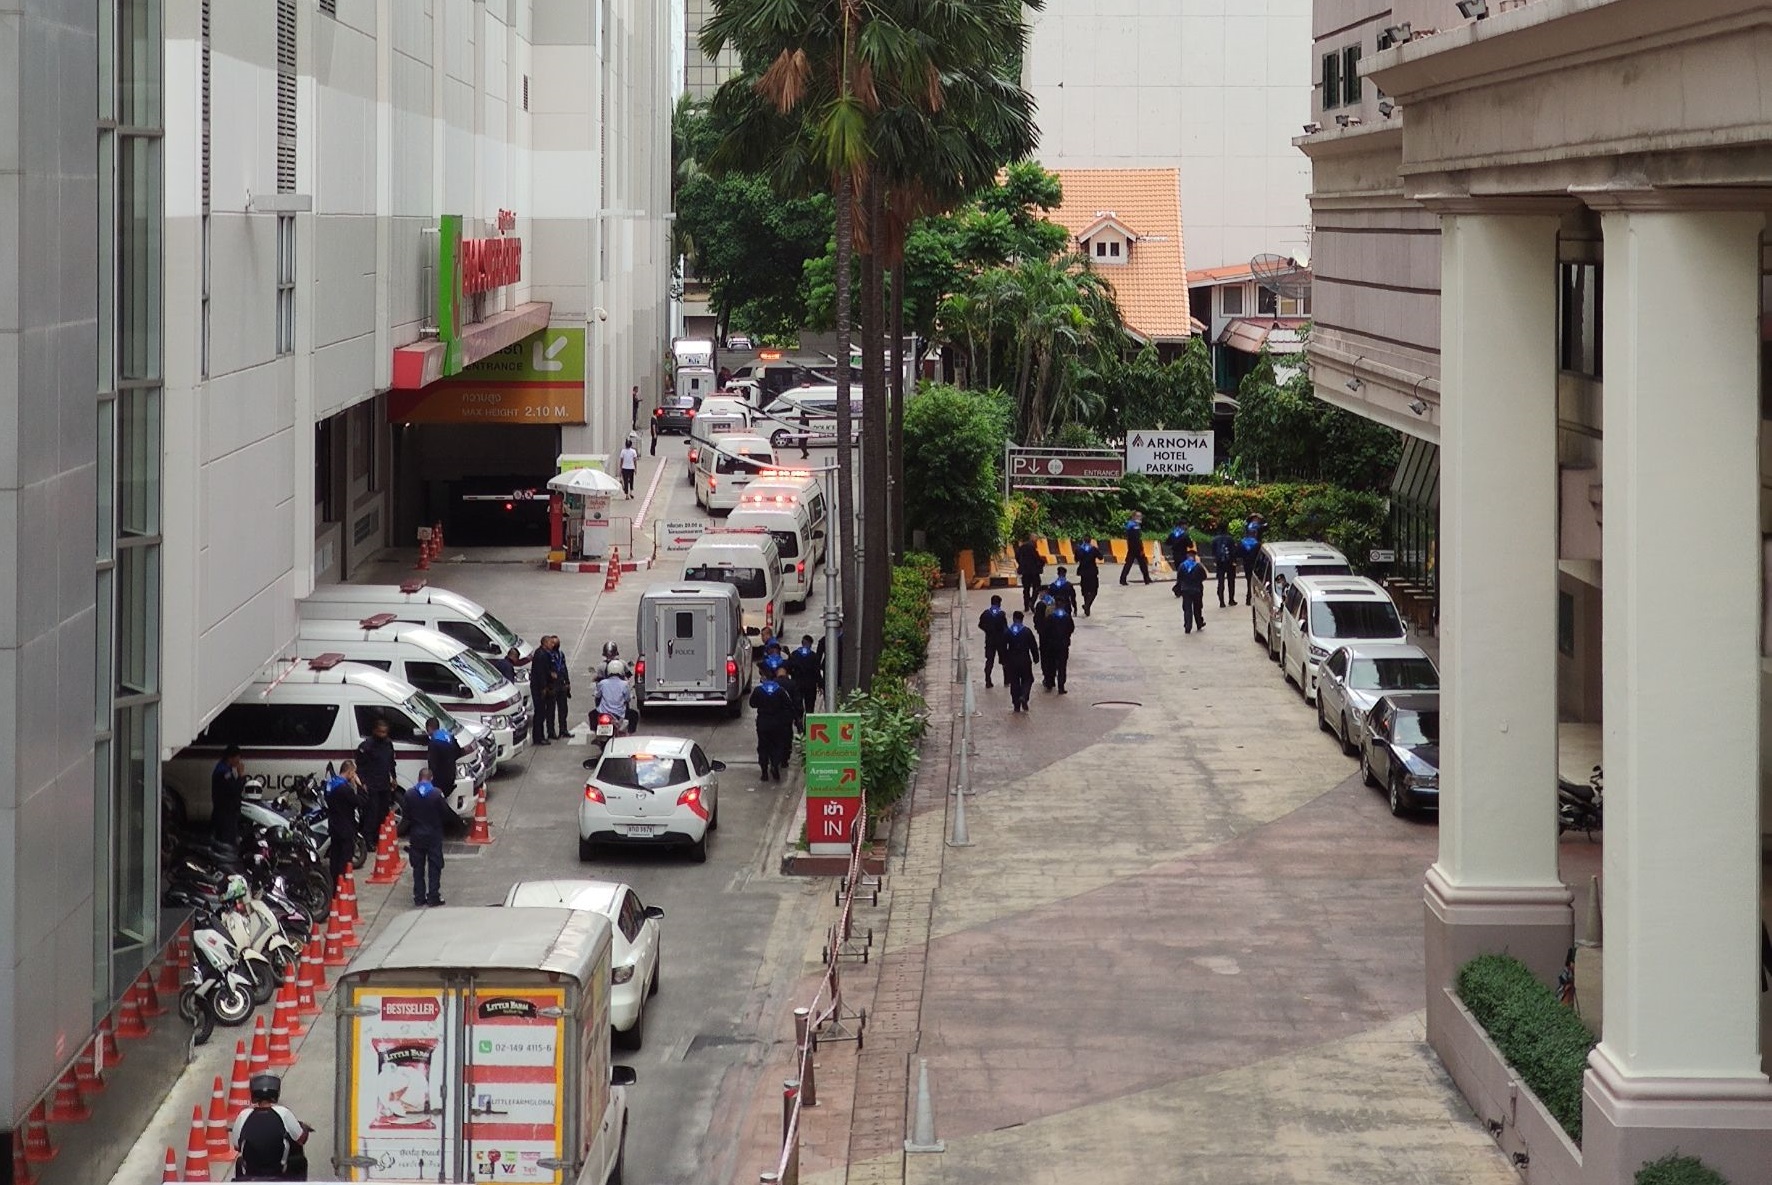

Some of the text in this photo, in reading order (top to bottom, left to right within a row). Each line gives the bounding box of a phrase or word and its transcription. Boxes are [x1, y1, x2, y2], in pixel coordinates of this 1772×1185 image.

[462, 406, 569, 417] MAX HEIGHT 2.10 M.
[1147, 438, 1208, 449] ARNOMA
[1153, 452, 1187, 460] HOTEL
[1014, 458, 1027, 474] P
[1146, 463, 1194, 473] PARKING
[1083, 469, 1120, 477] ENTRANCE
[810, 767, 839, 775] Arnoma
[823, 800, 844, 816] เข้า
[823, 820, 843, 836] IN
[386, 1003, 435, 1015] BESTSELLER
[485, 1002, 510, 1012] LITTLE
[510, 1000, 529, 1011] FARM
[495, 1044, 552, 1052] 02-149 4115-6
[384, 1050, 410, 1061] LITTLE
[491, 1098, 555, 1106] LITTLEFARMGLOBAL
